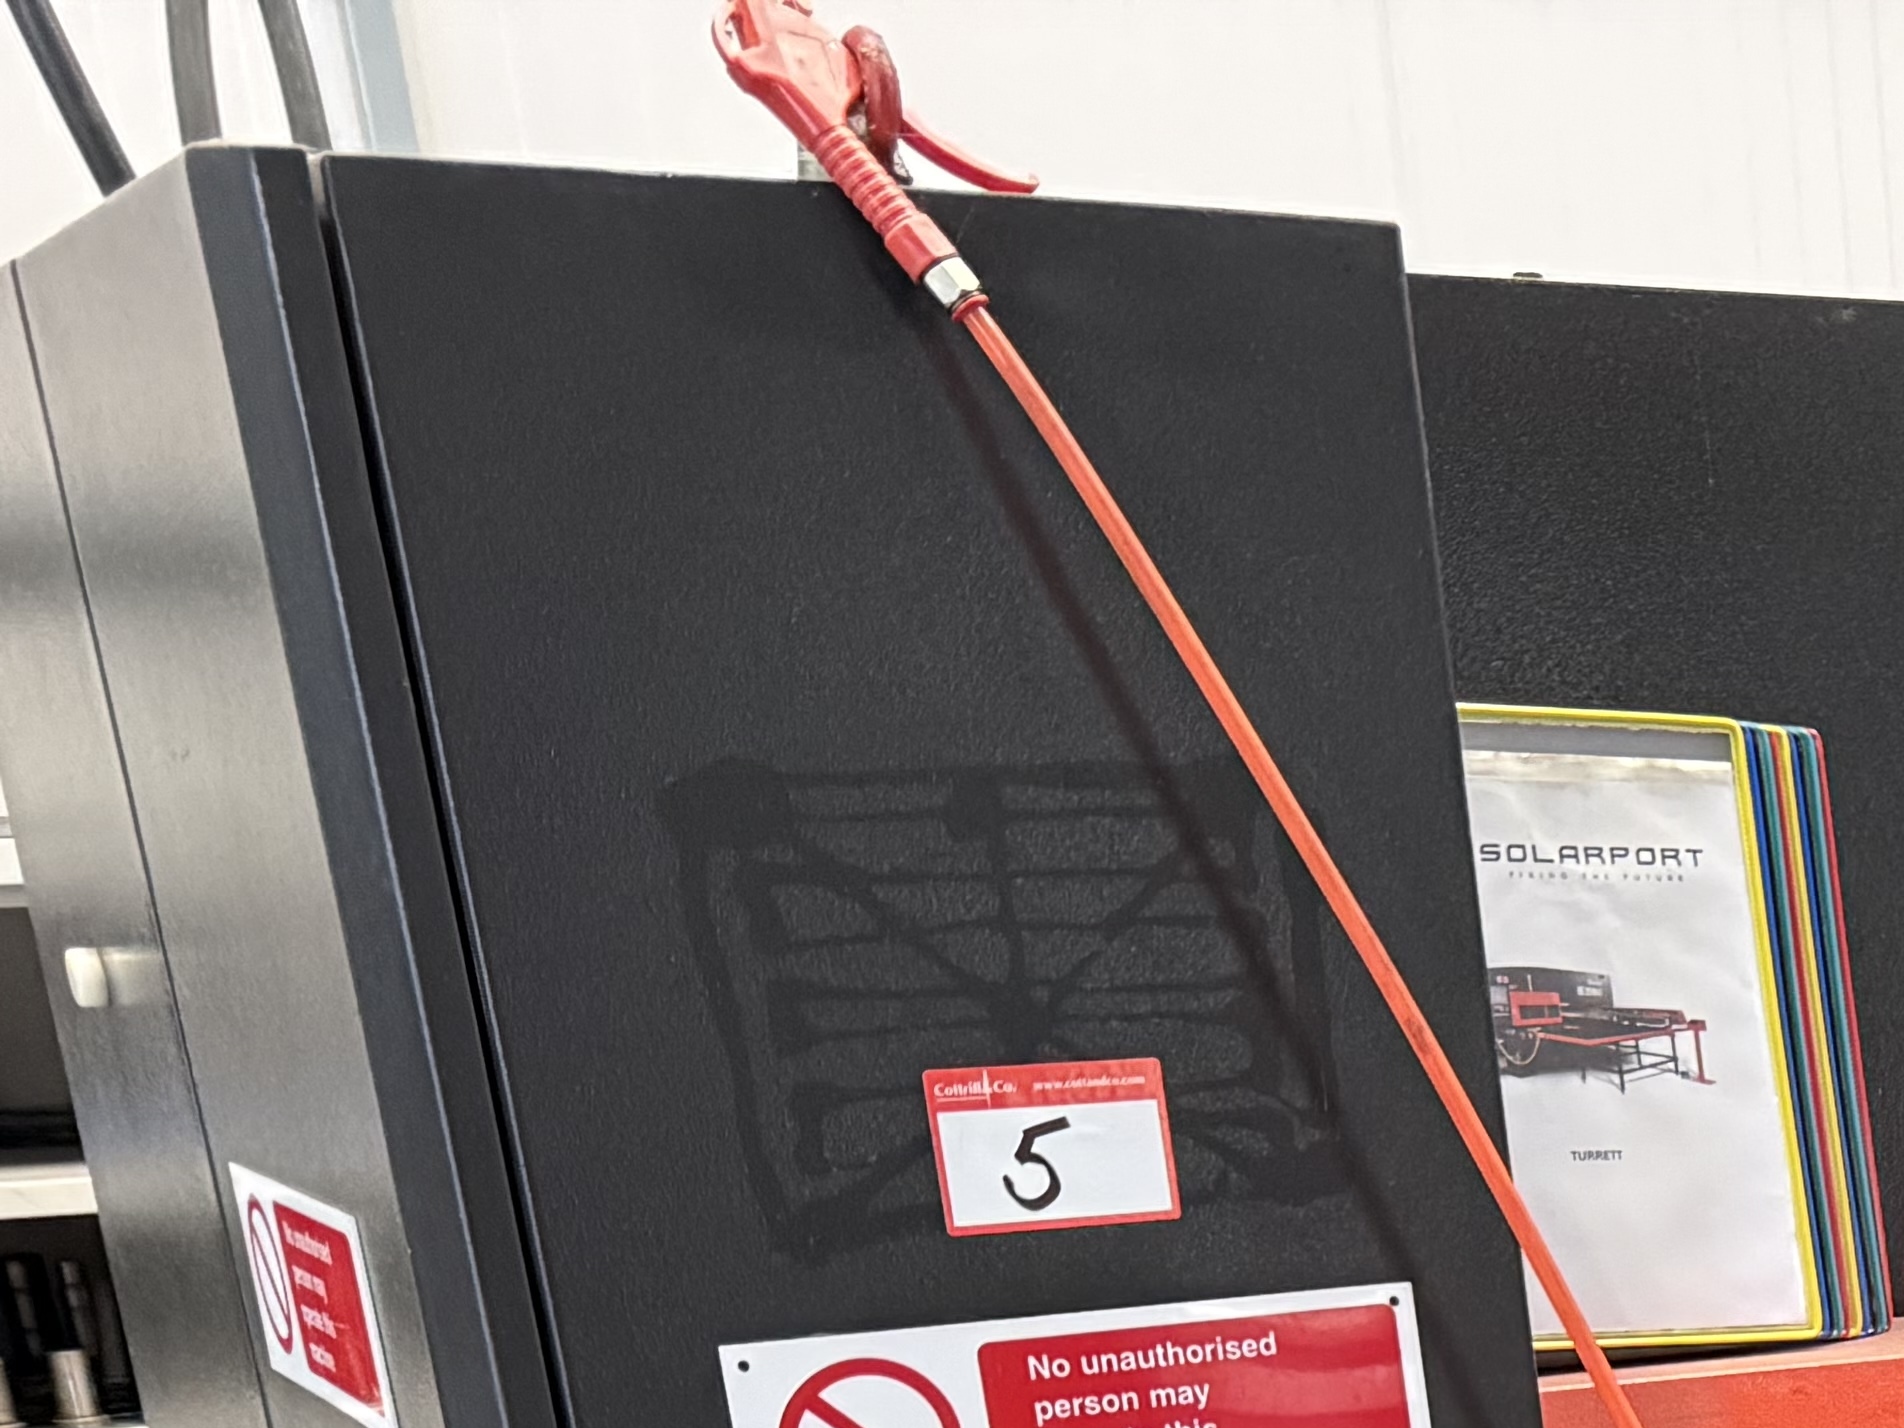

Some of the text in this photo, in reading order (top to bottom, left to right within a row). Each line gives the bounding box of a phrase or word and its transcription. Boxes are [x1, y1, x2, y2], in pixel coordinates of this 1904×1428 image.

[1479, 844, 1704, 868] SOLARPORT
[1002, 1116, 1071, 1212] 5
[1027, 1331, 1277, 1381] No unauthorised
[1034, 1383, 1210, 1427] person may
